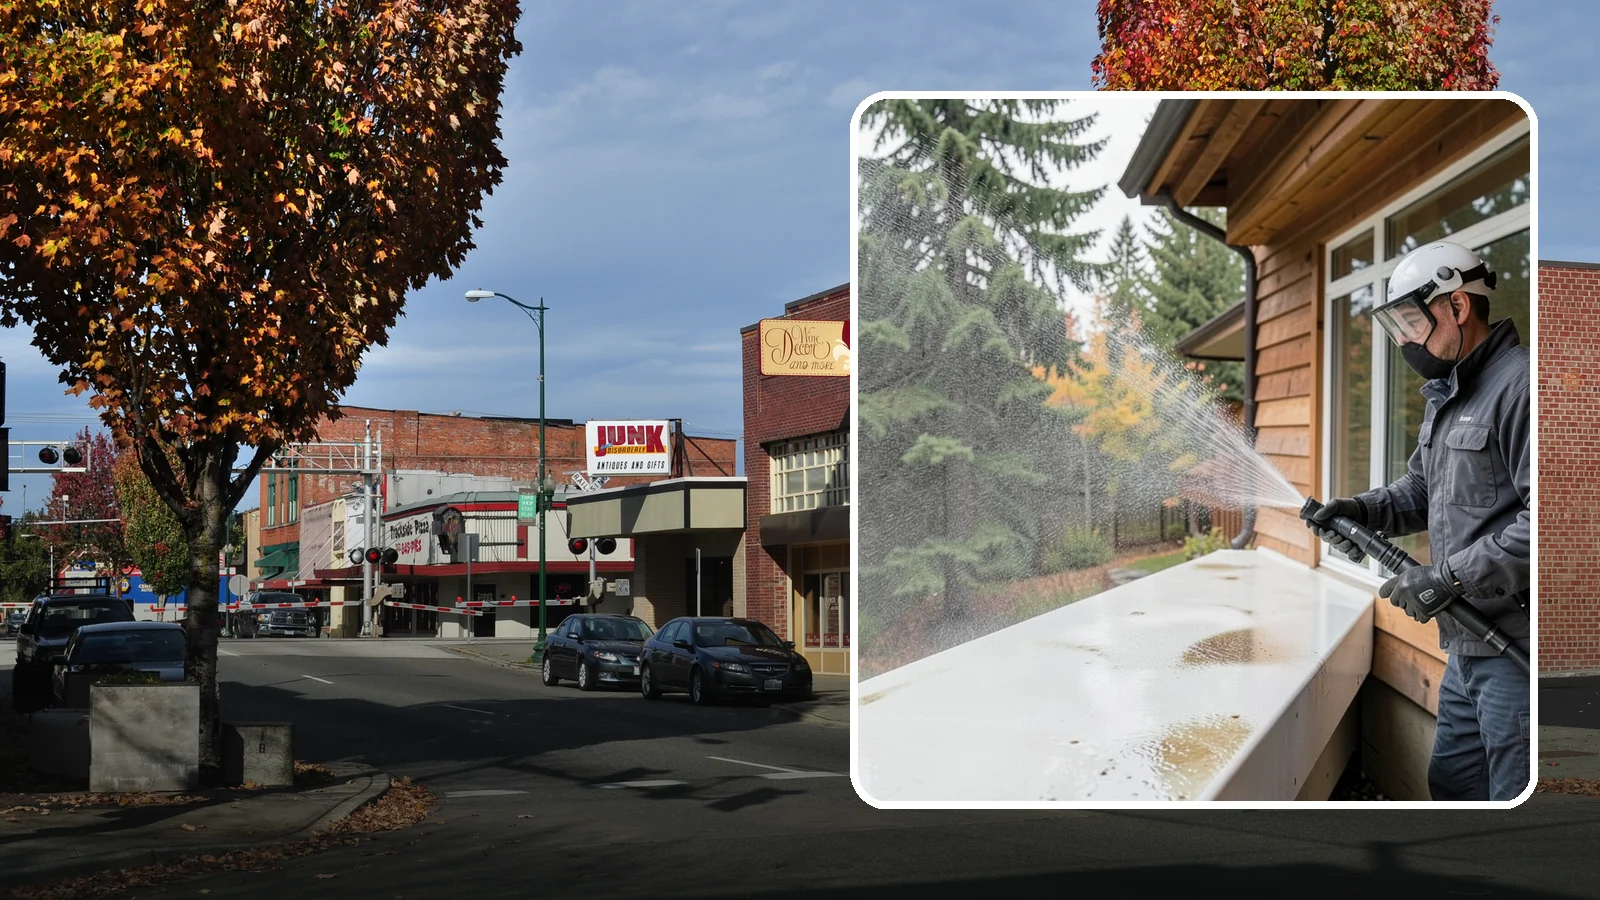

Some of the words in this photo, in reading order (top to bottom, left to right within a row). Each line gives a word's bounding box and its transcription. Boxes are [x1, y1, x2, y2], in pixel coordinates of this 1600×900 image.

[595, 425, 665, 457] JUNK
[607, 446, 645, 454] DISORDERLY
[596, 461, 628, 470] ANTIQUES
[631, 461, 644, 470] AND
[647, 460, 665, 470] GIFTS
[390, 521, 413, 540] Trackside
[414, 519, 429, 535] Pizza
